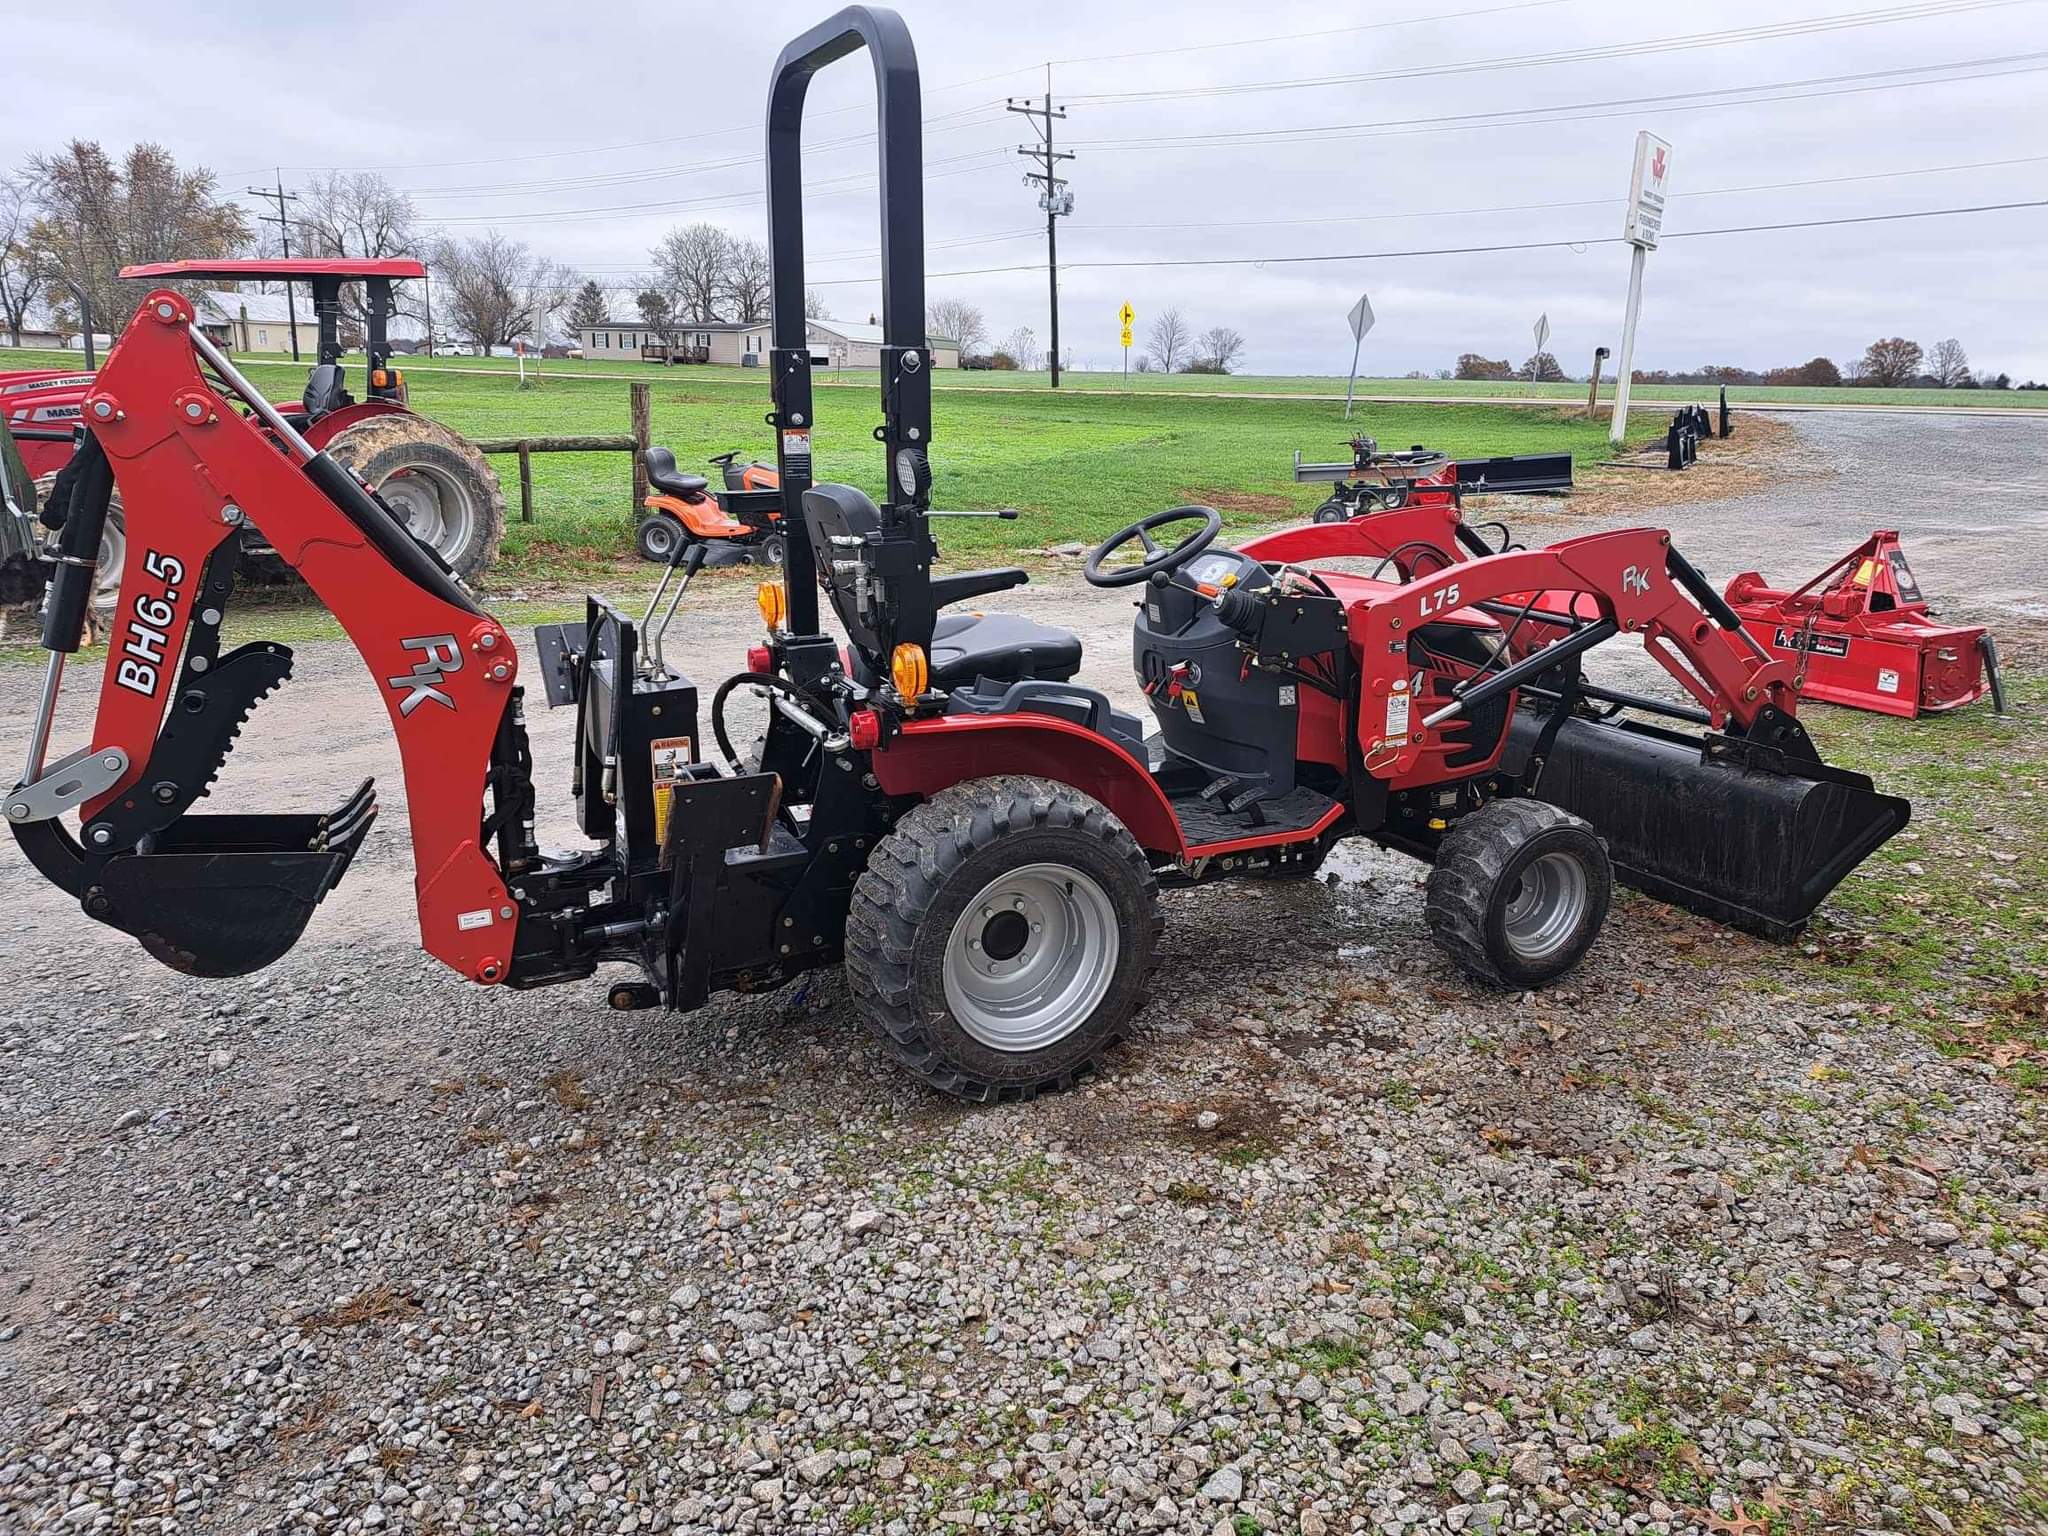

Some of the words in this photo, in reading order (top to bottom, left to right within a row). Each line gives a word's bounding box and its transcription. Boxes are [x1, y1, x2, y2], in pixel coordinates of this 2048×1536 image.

[28, 381, 58, 389] MASSEY
[1622, 564, 1650, 597] RK
[115, 549, 185, 698] BH6.5
[387, 633, 464, 718] RK
